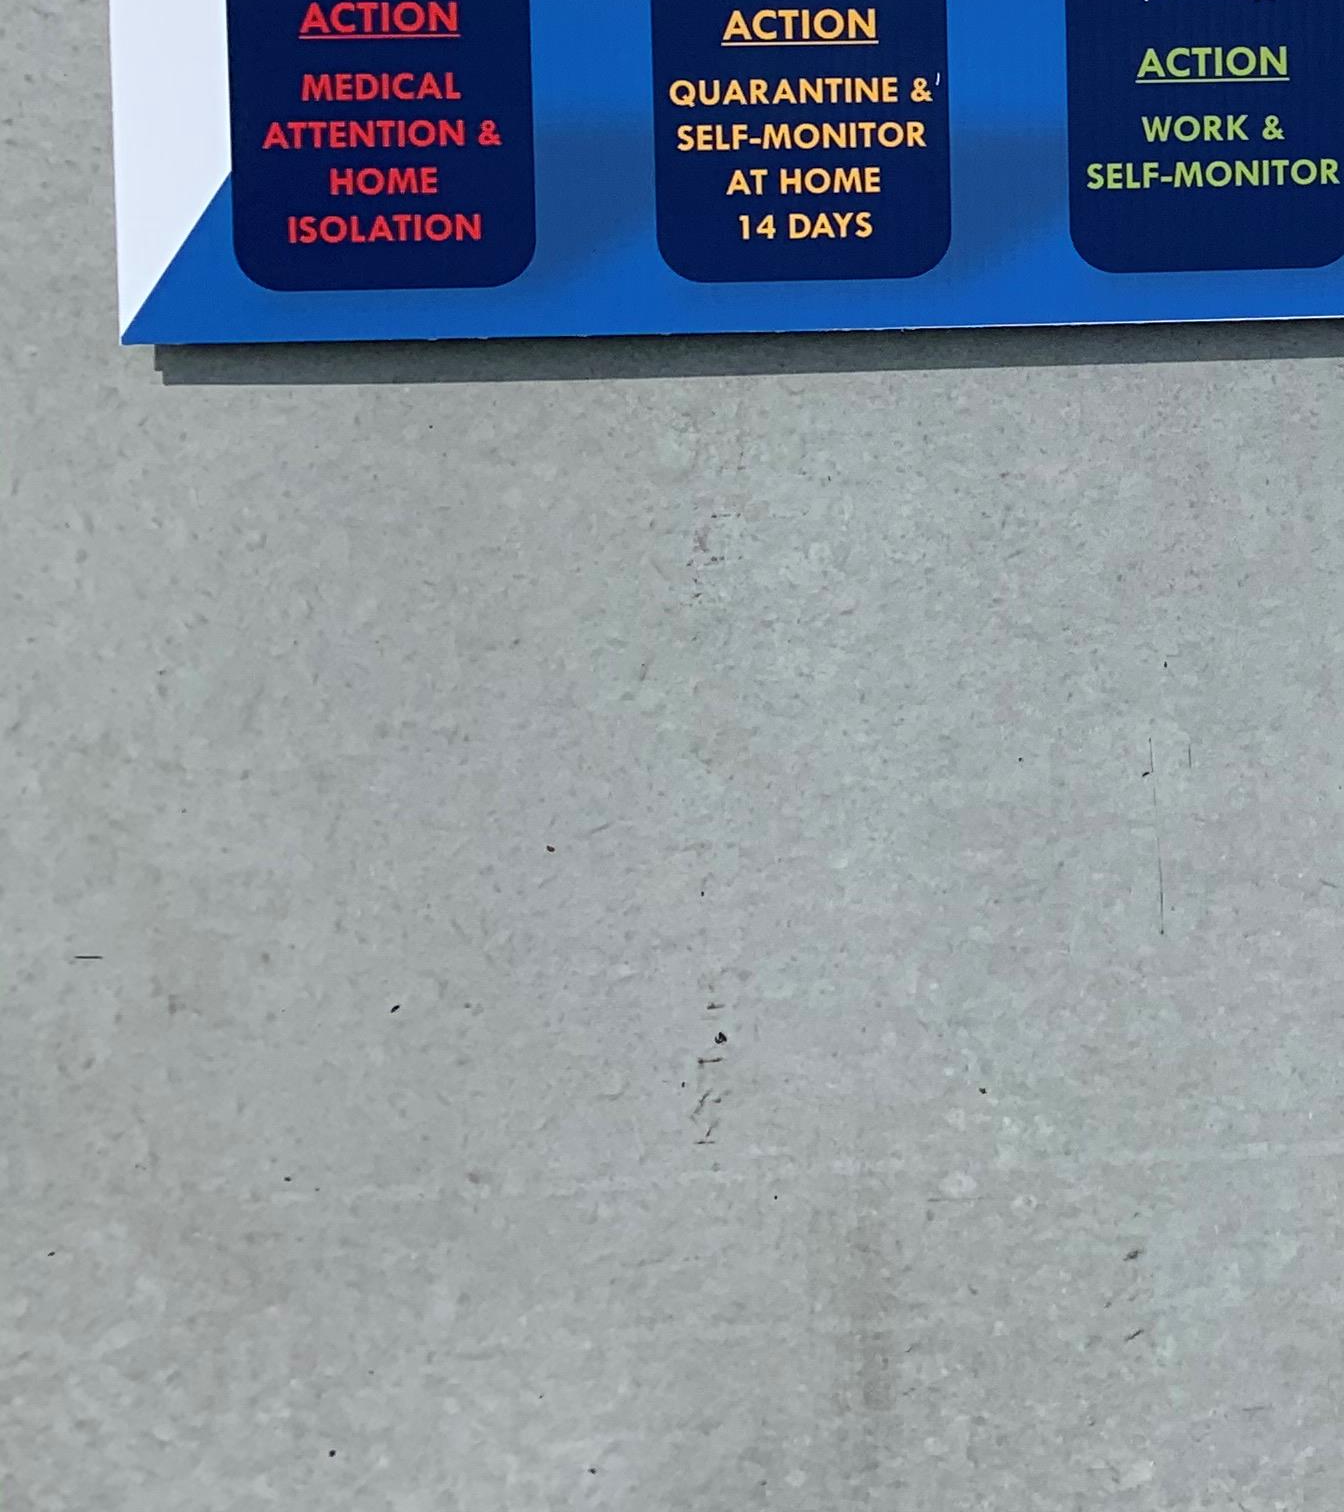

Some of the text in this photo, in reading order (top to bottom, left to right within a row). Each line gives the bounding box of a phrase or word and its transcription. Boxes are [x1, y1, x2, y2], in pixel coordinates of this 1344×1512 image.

[298, 1, 461, 40] ACTION
[720, 8, 880, 47] ACTION
[1135, 45, 1291, 84] ACTION
[301, 71, 462, 102] MEDICAL
[669, 76, 933, 108] QUARANTINE &
[262, 119, 502, 150] ATTENTION &
[677, 121, 927, 152] SELF-MONITOR
[1141, 114, 1285, 143] WORK &
[329, 166, 438, 196] HOME
[726, 166, 881, 196] AT HOME
[1086, 158, 1341, 190] SELF-MONITOR
[288, 213, 482, 244] ISOLATION
[739, 211, 873, 240] 14 DAYS
